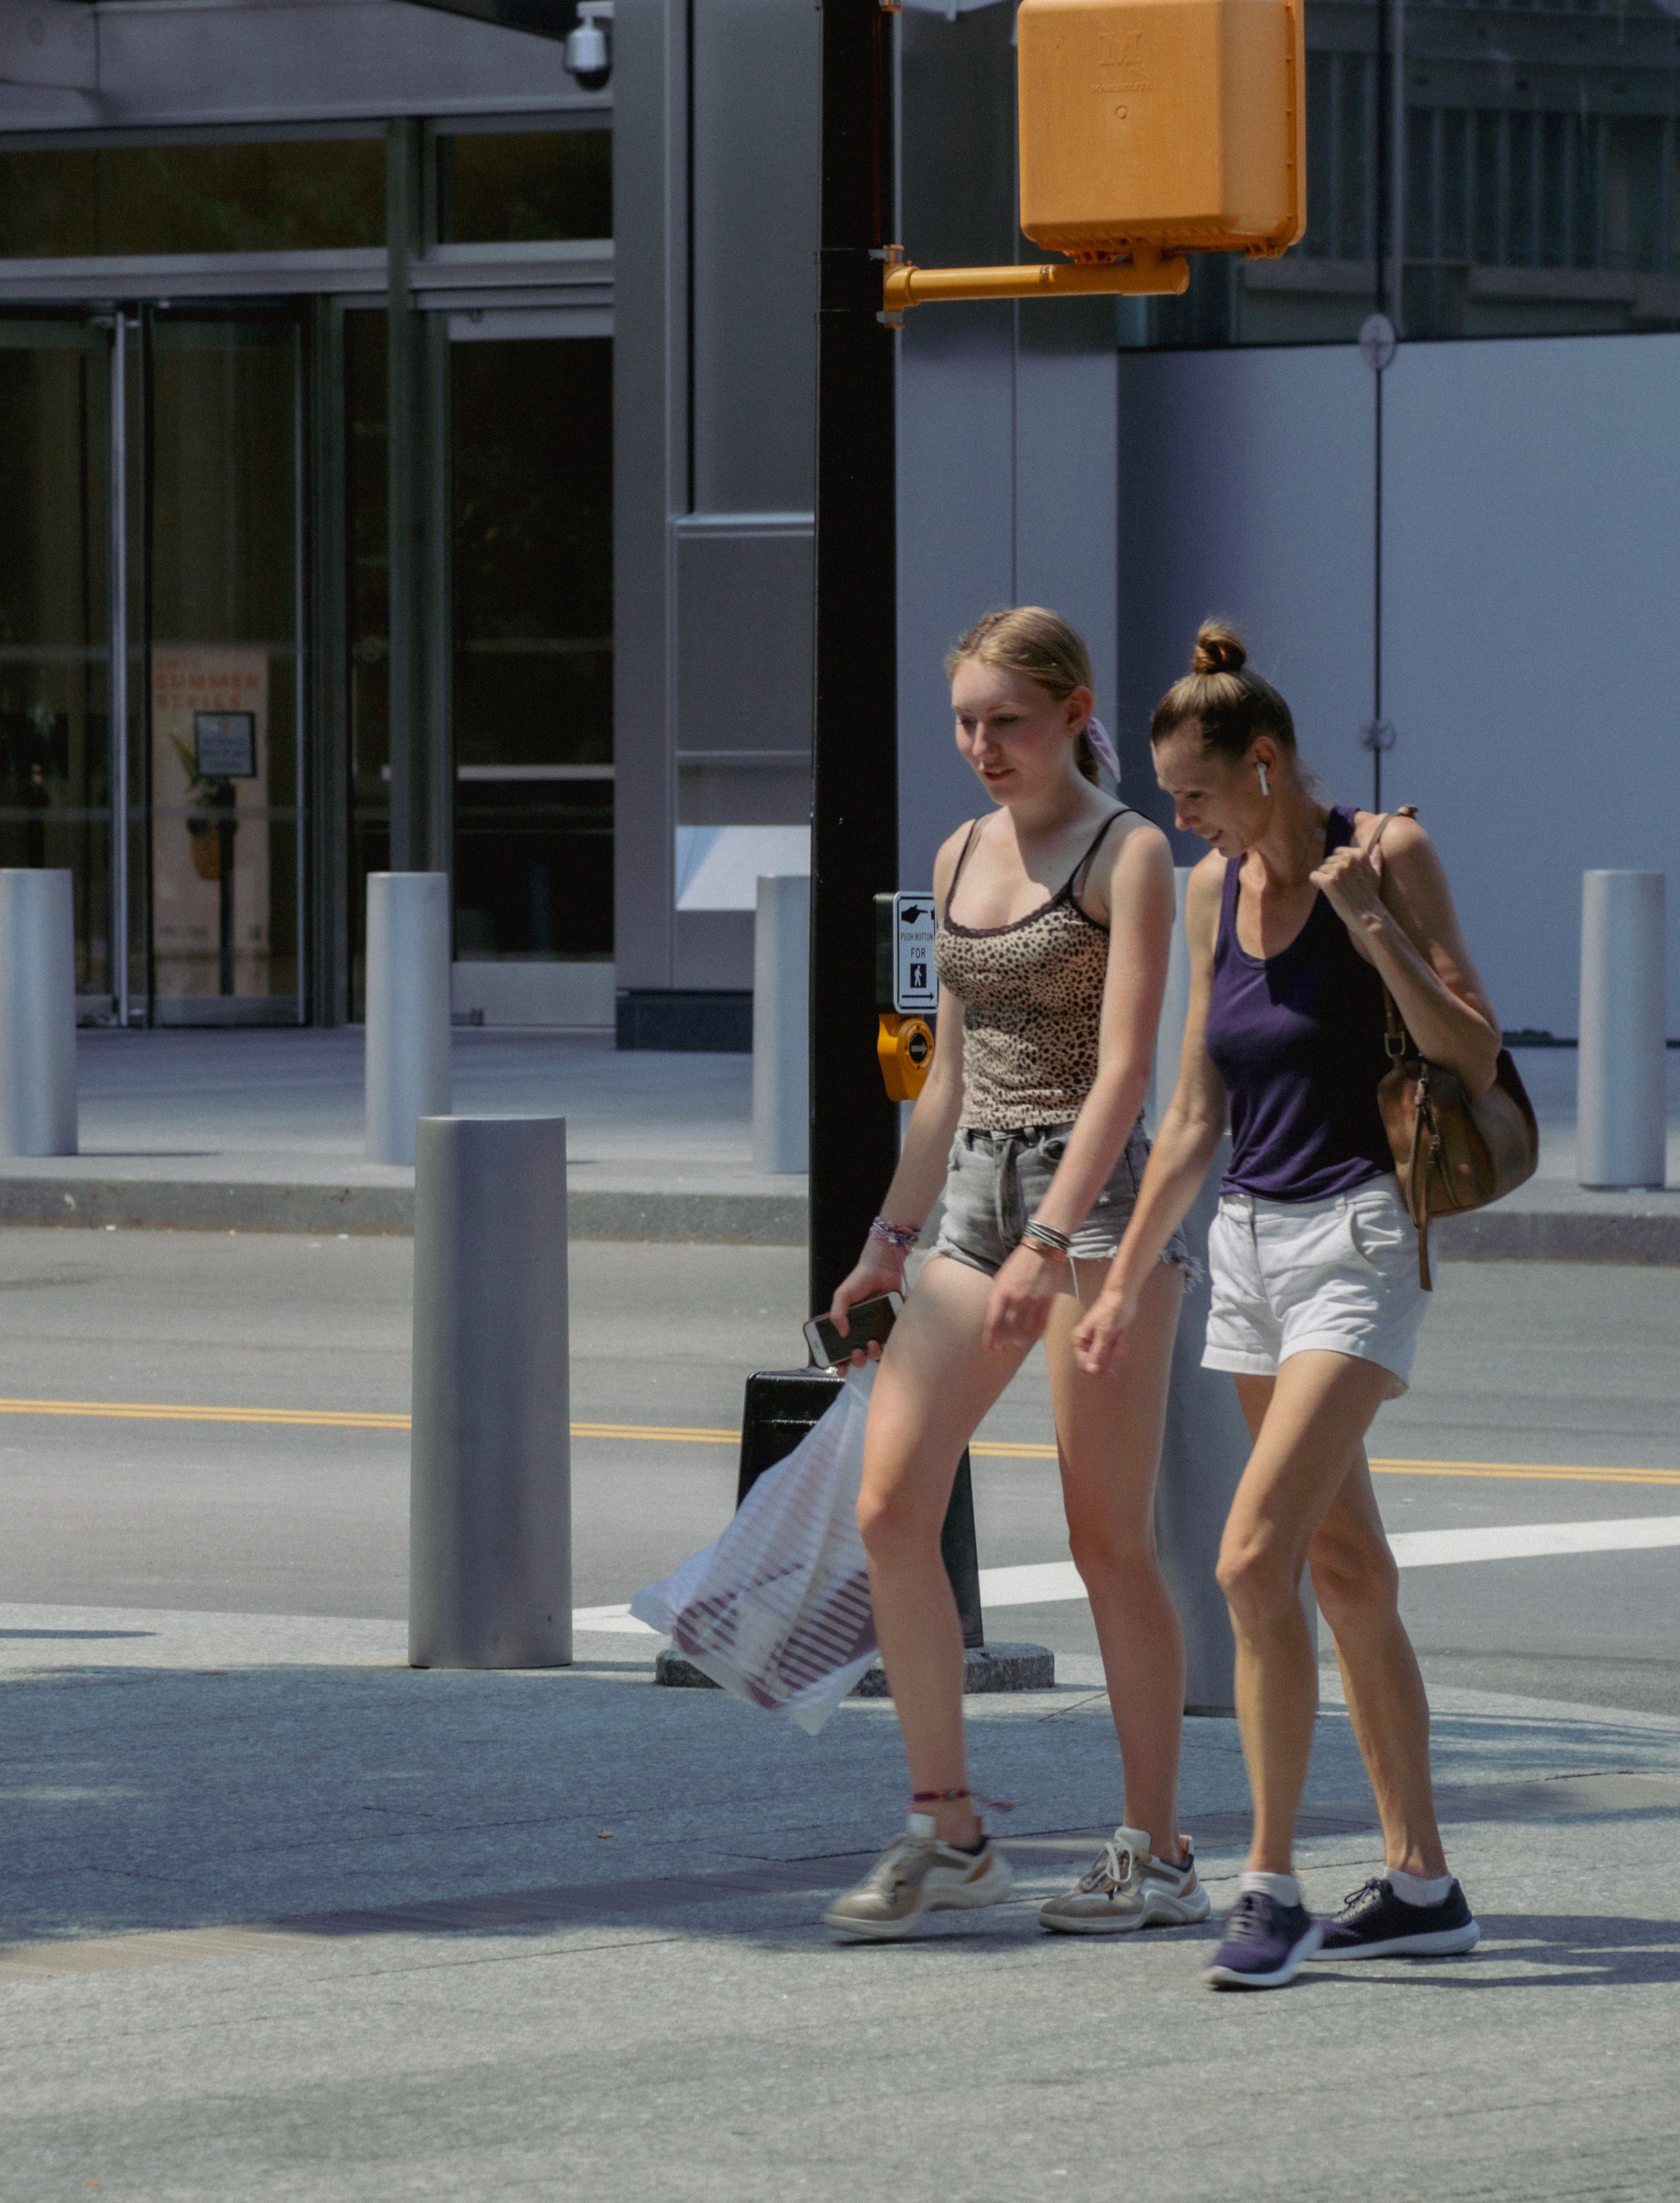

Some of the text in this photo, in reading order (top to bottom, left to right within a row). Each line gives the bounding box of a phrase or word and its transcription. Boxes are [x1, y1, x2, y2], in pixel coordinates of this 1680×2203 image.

[901, 932, 933, 941] PUSH BUTTON
[911, 948, 926, 958] FOR
